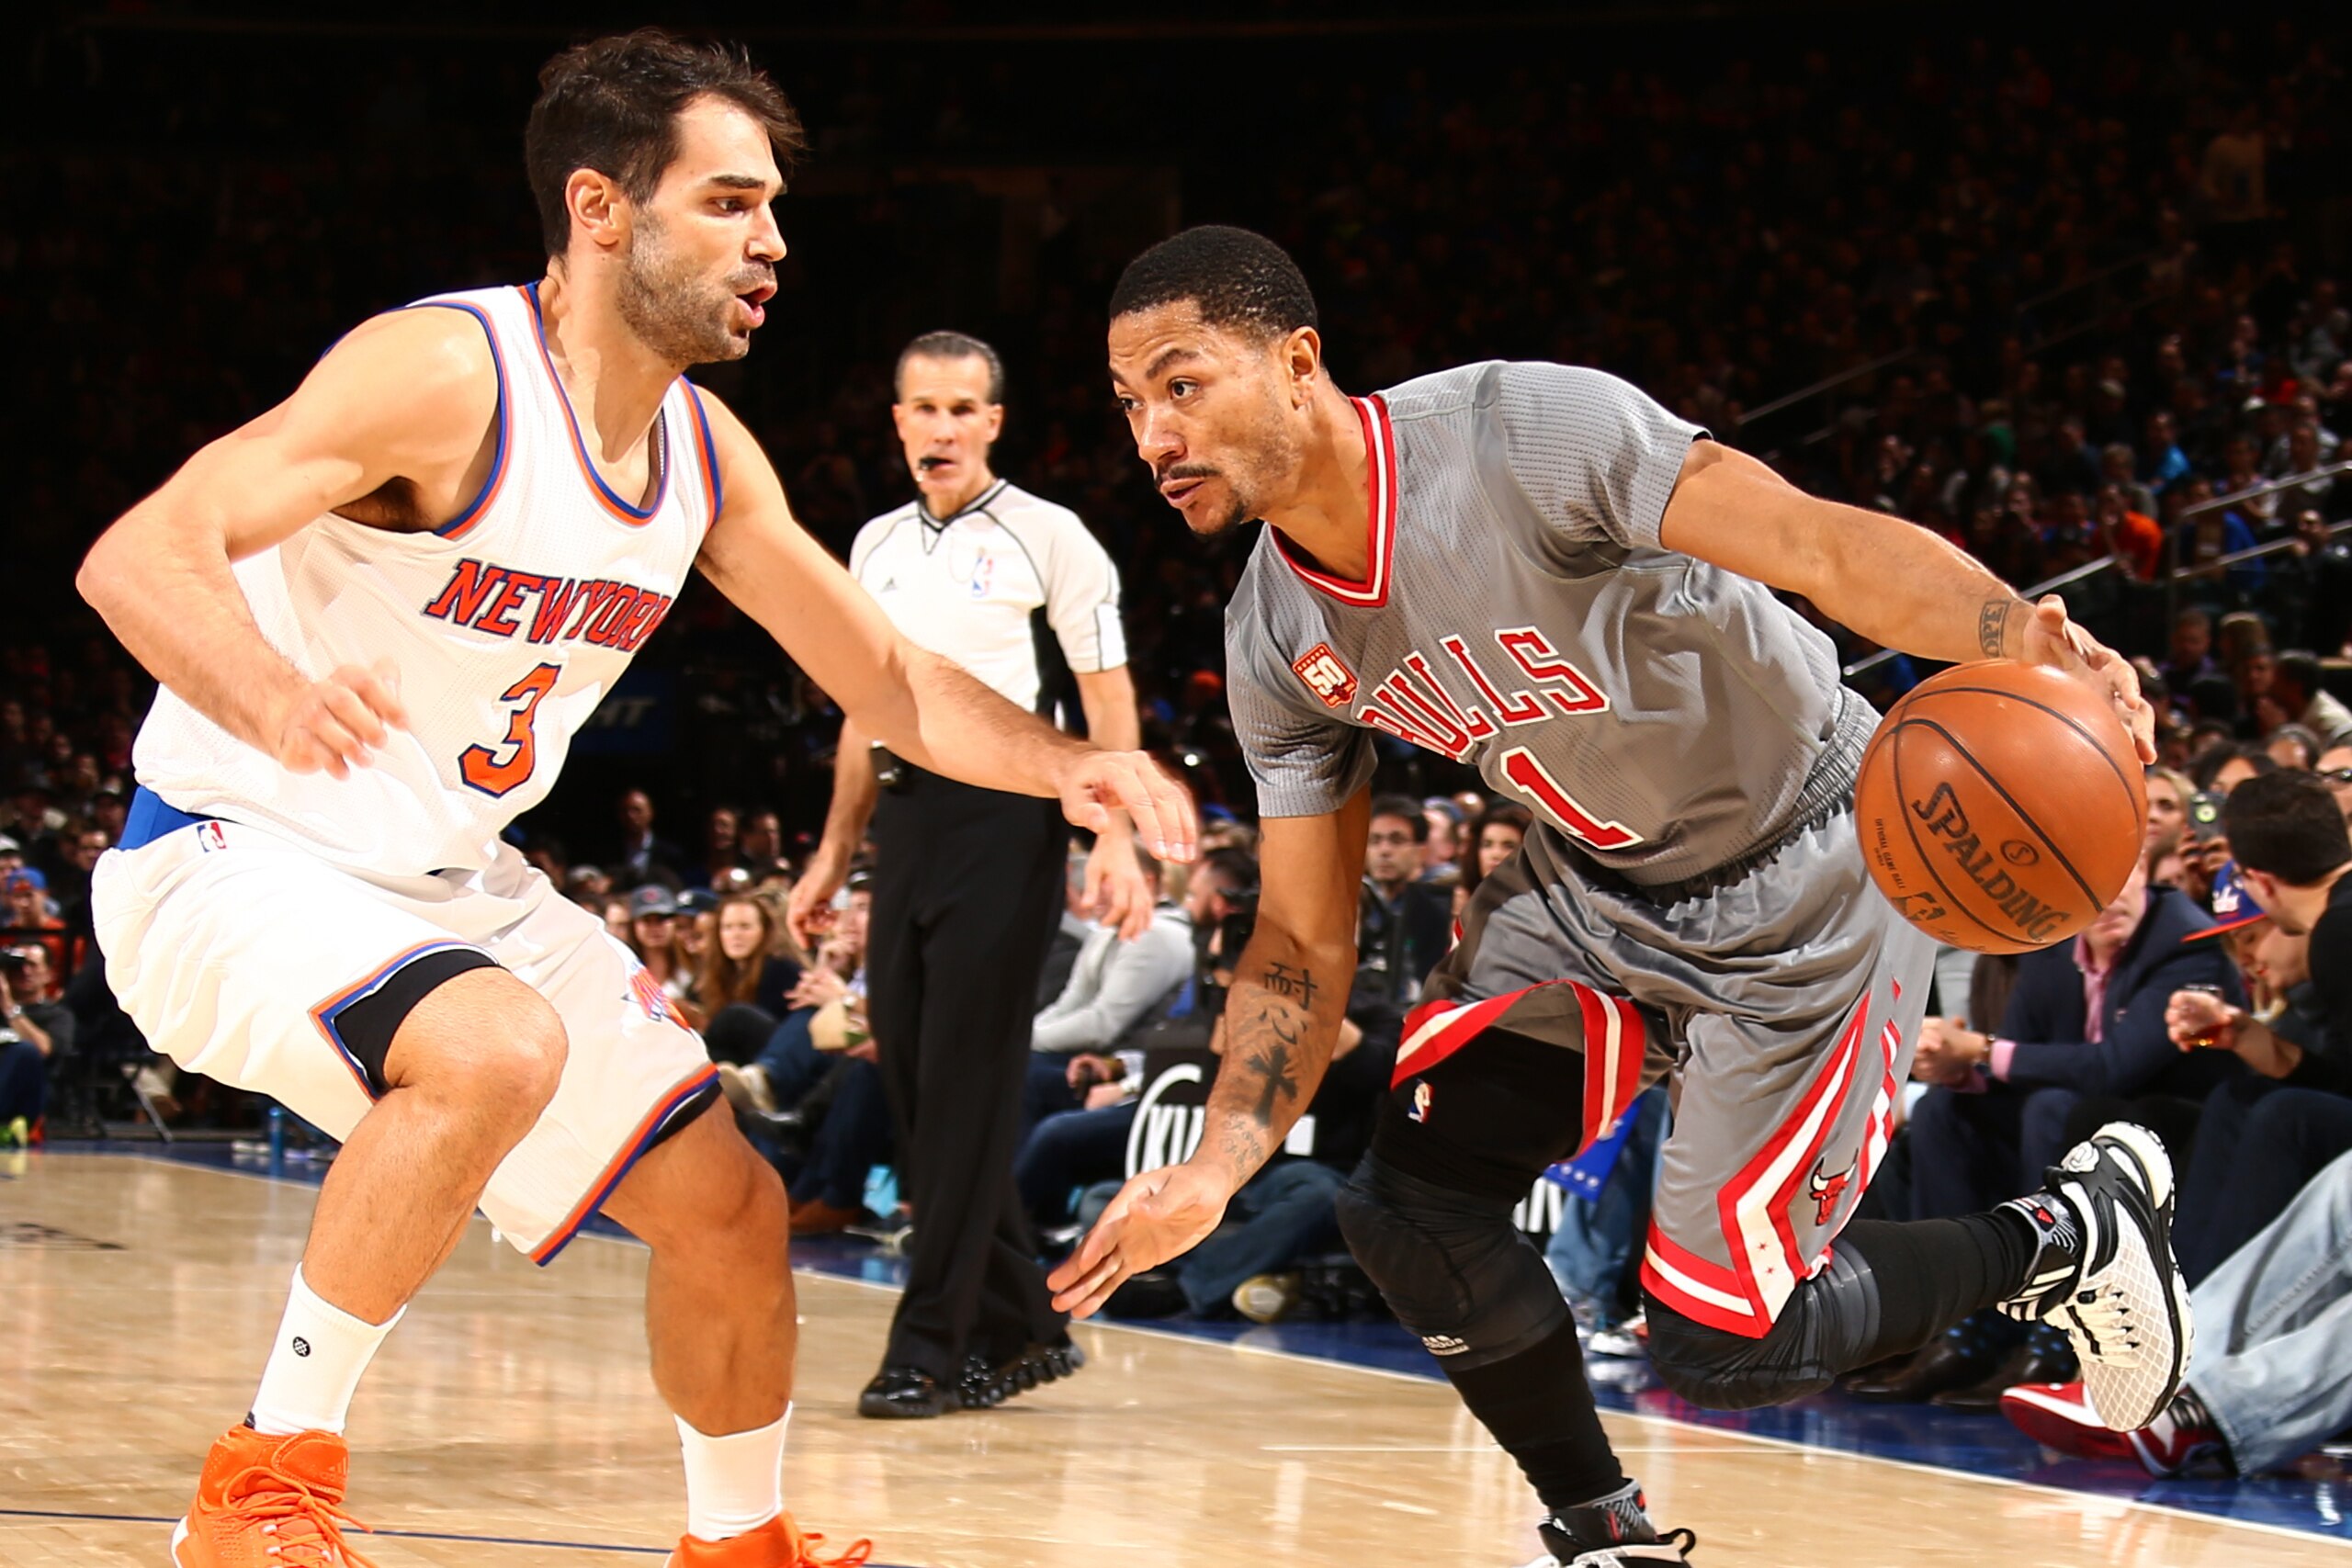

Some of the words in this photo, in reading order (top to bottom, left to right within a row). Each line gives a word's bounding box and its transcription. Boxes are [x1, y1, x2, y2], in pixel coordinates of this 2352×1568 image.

[423, 558, 576, 644] NEW
[1302, 655, 1348, 696] 50
[458, 661, 561, 799] 3
[1500, 745, 1645, 851] 1
[1911, 782, 2072, 942] SPALDING
